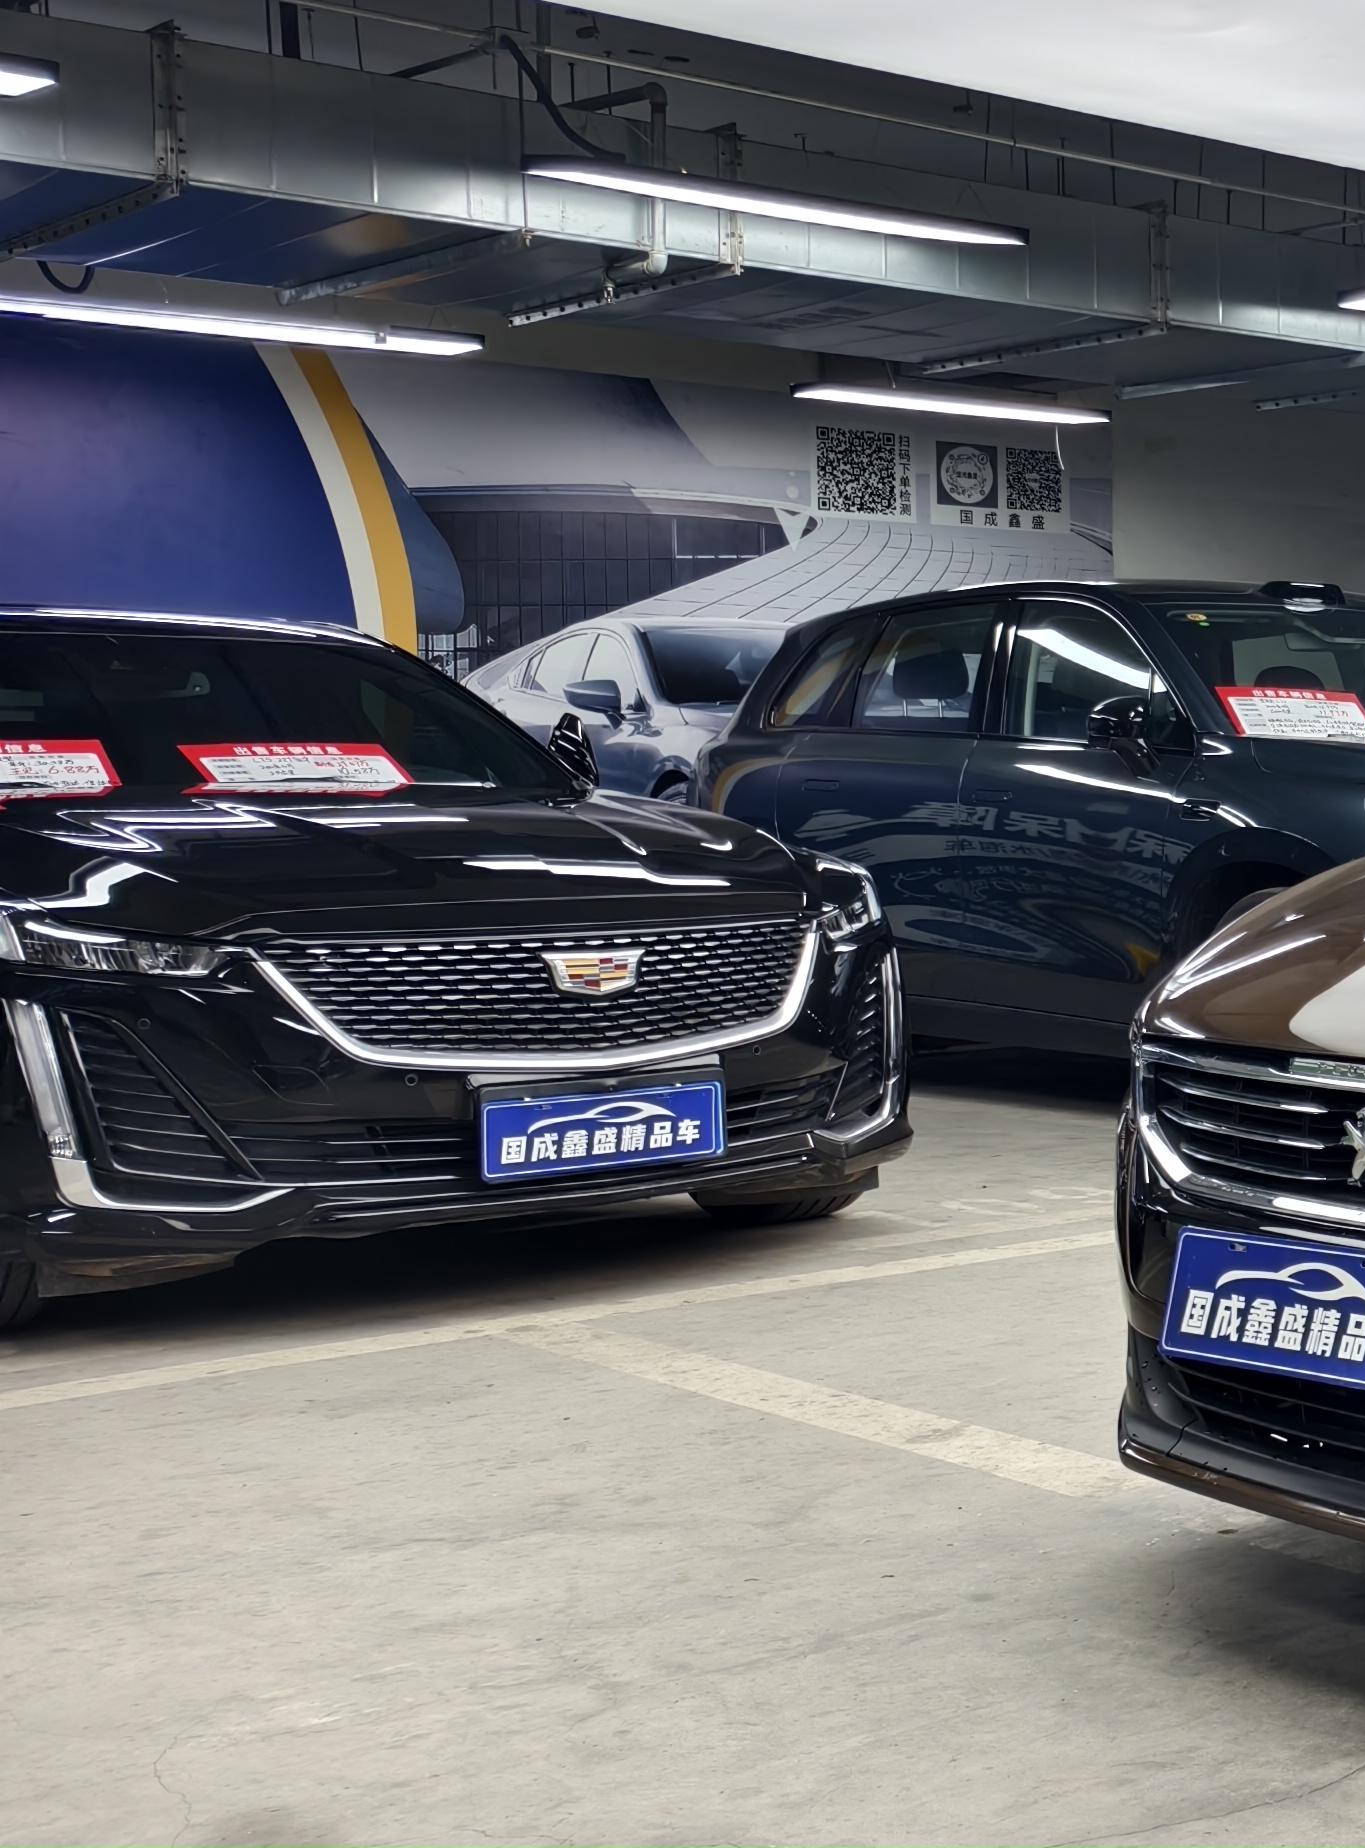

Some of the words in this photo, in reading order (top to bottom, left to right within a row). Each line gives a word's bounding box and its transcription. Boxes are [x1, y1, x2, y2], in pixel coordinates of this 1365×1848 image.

[898, 434, 912, 516] 扫码下单检测
[960, 510, 1044, 529] 国成鑫盛
[0, 744, 47, 753] 信息
[500, 1119, 701, 1165] 国成鑫盛精品车
